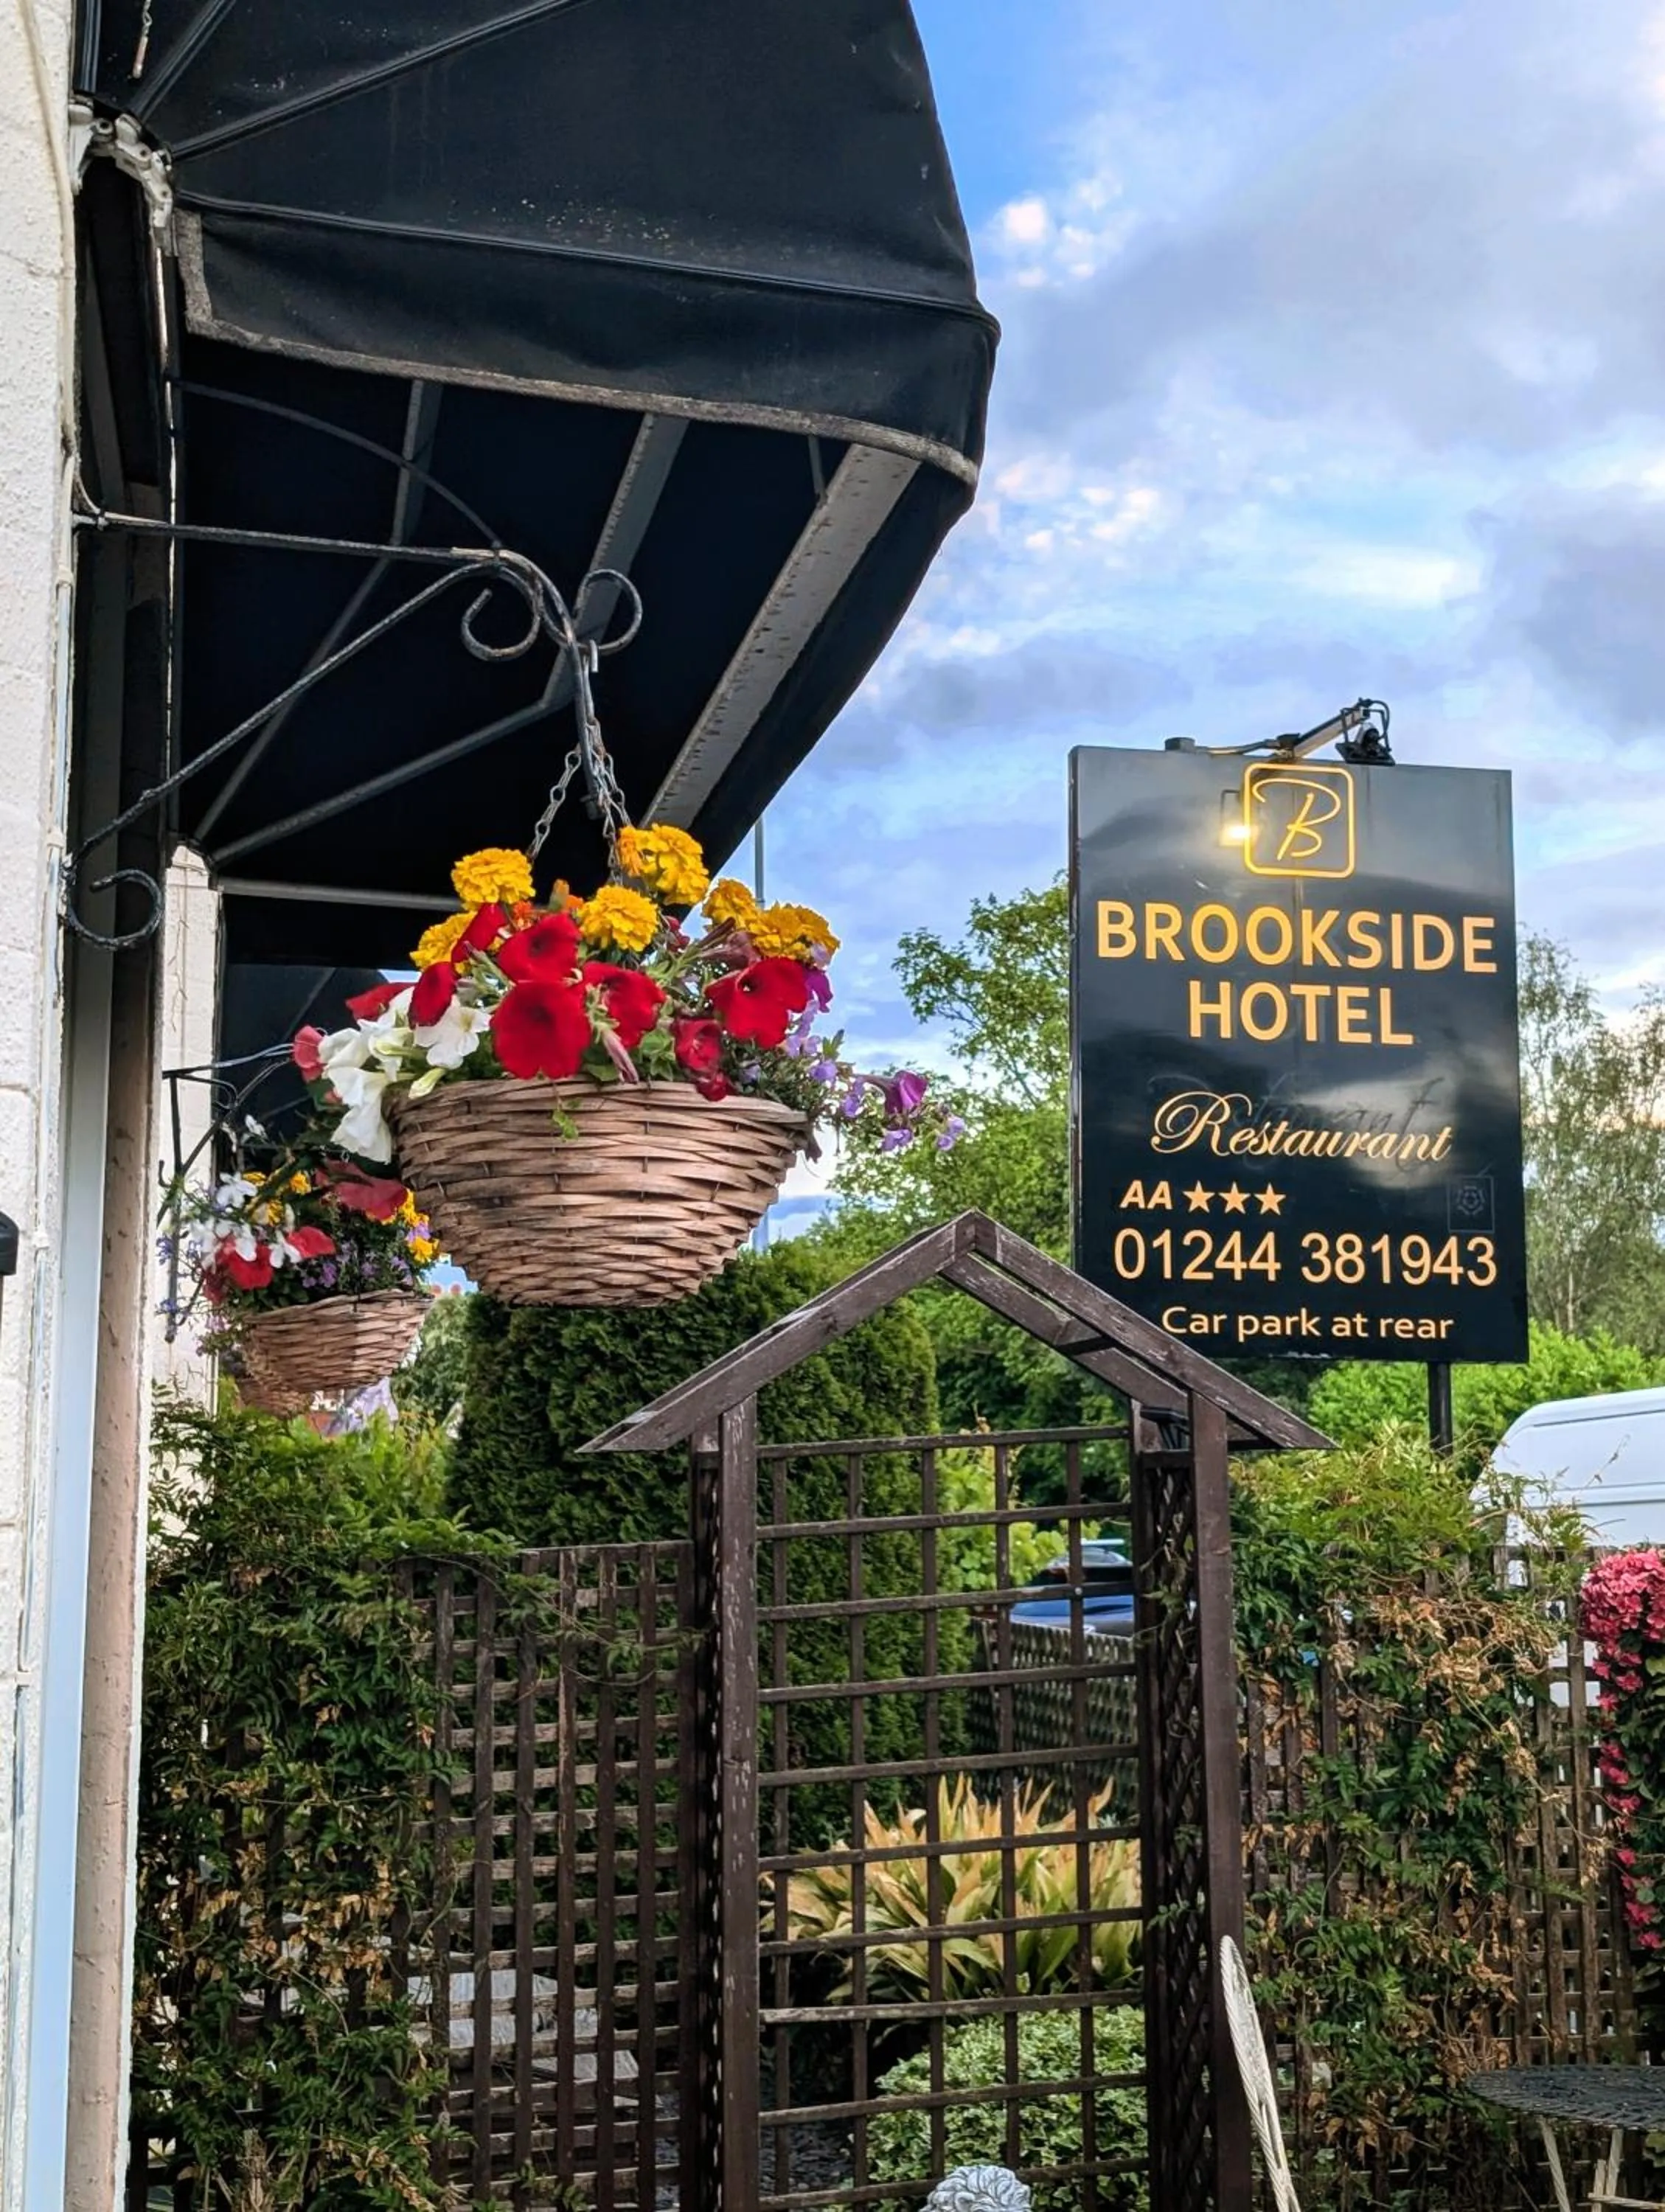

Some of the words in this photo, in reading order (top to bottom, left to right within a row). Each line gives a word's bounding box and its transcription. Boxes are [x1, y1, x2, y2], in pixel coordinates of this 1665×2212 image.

[1252, 778, 1341, 861] B
[1096, 900, 1497, 973] BROOKSIDE
[1189, 979, 1414, 1046] HOTEL
[1150, 1091, 1452, 1161] Restaurant
[1120, 1179, 1172, 1209] AA
[1114, 1228, 1281, 1281] 01244
[1301, 1232, 1497, 1287] 381943
[1162, 1307, 1225, 1335] Car
[1238, 1309, 1318, 1341] park
[1332, 1312, 1367, 1338] at
[1380, 1318, 1453, 1340] rear
